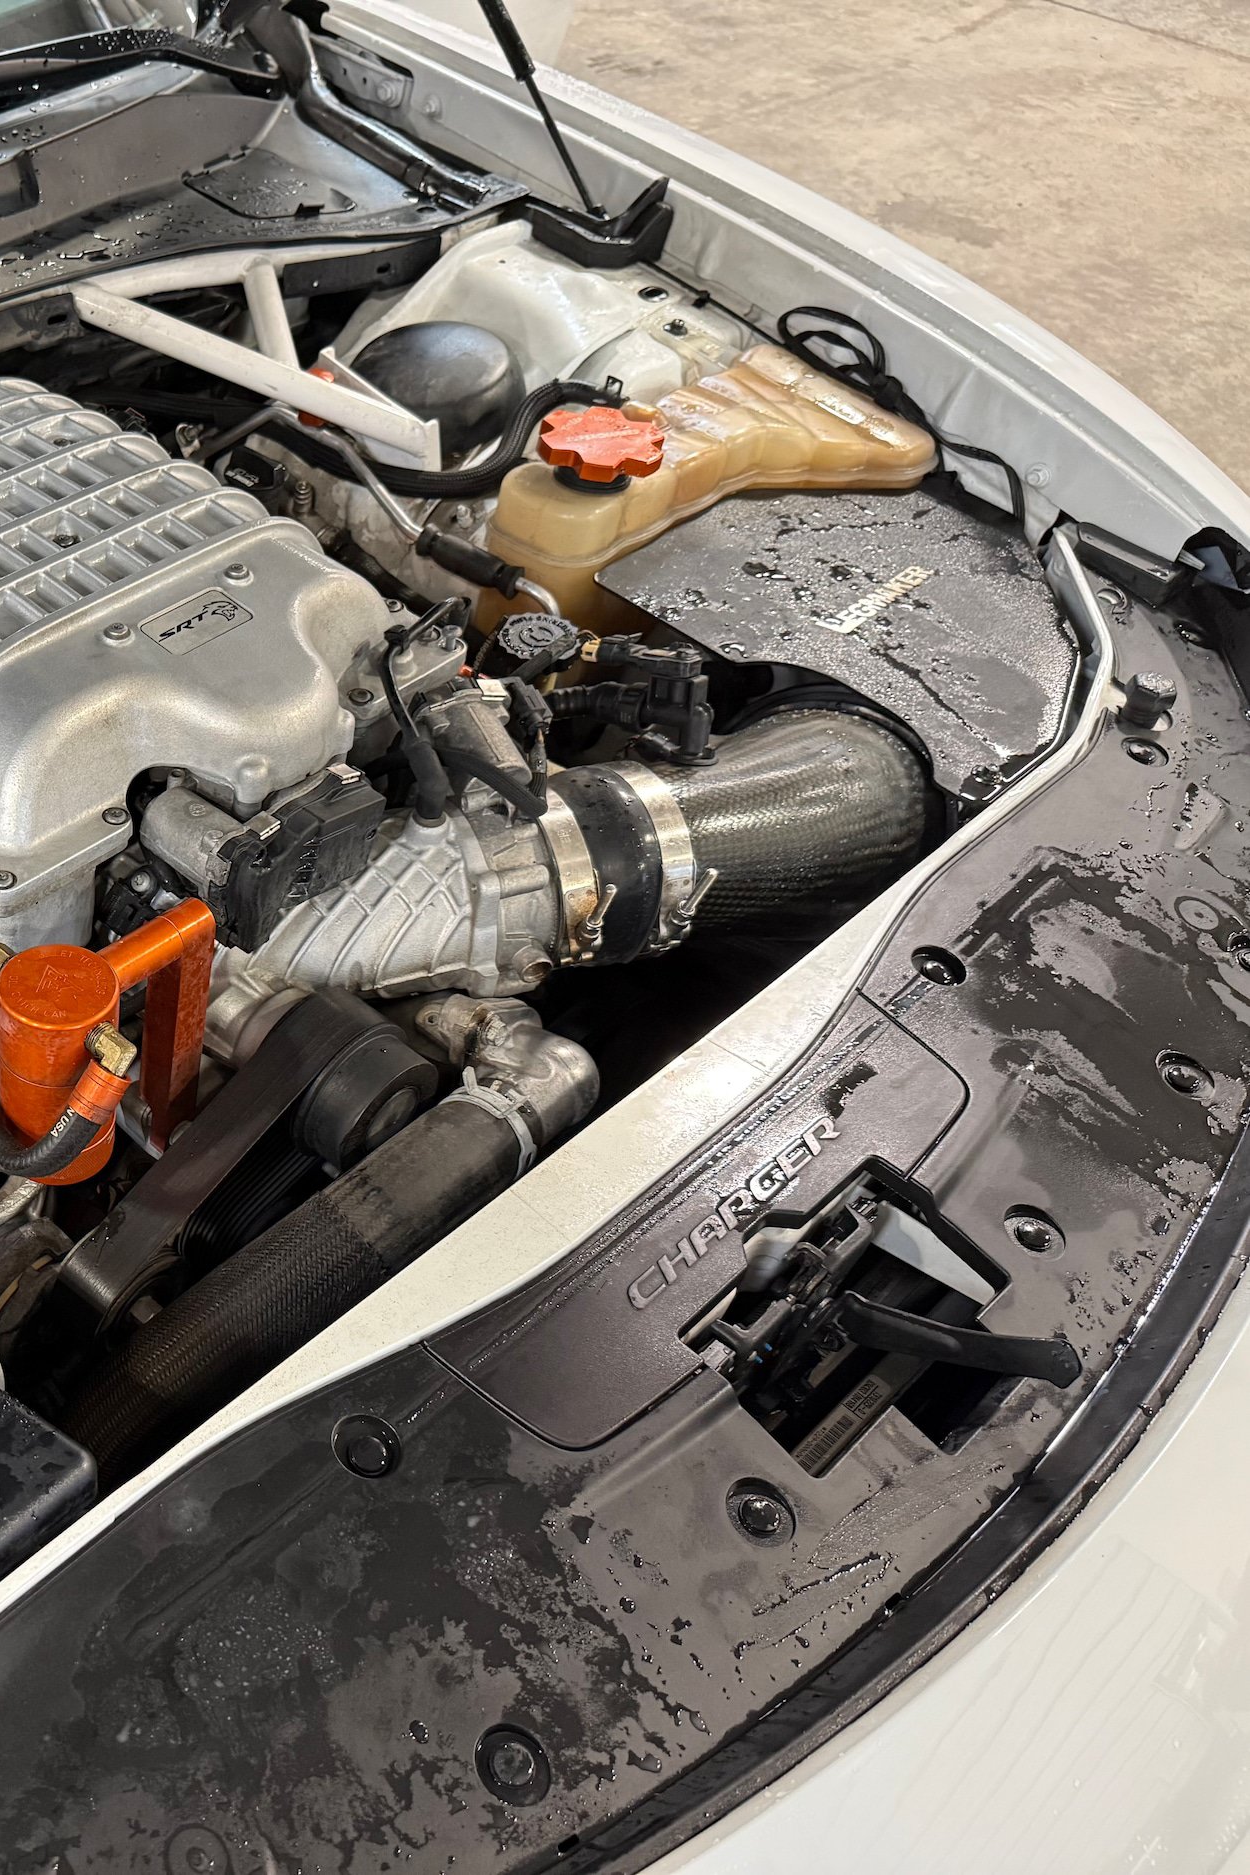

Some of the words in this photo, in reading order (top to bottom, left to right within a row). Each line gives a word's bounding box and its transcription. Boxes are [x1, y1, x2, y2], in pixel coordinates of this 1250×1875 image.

[159, 610, 208, 642] SRT
[44, 1010, 66, 1019] CAN
[50, 1116, 70, 1138] USA
[627, 1116, 842, 1310] CHARGER
